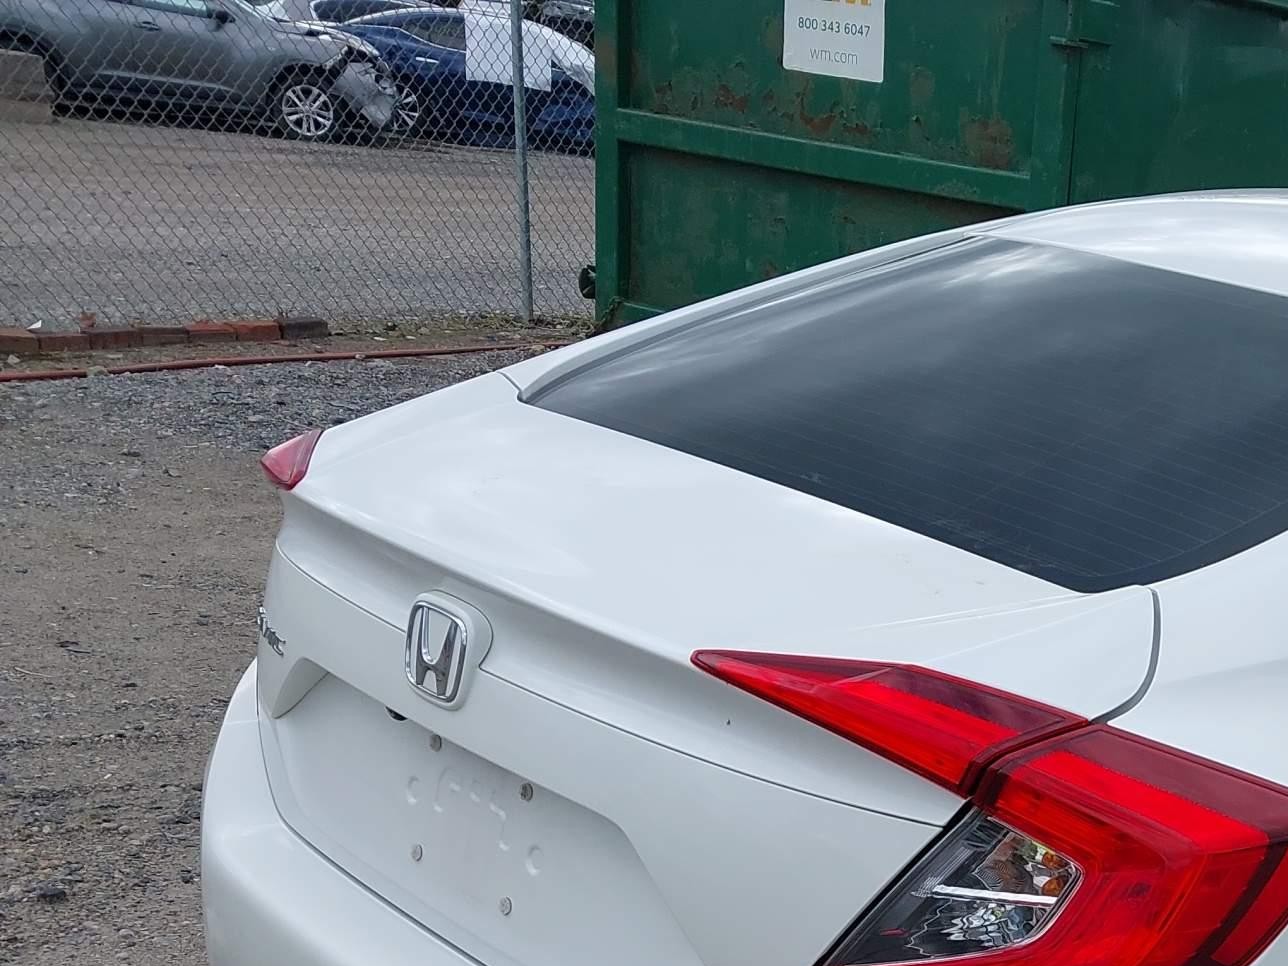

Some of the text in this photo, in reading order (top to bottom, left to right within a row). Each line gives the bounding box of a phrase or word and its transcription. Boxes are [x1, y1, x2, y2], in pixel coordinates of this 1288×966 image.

[797, 16, 871, 38] 800 343 6047
[809, 48, 858, 65] wm.com
